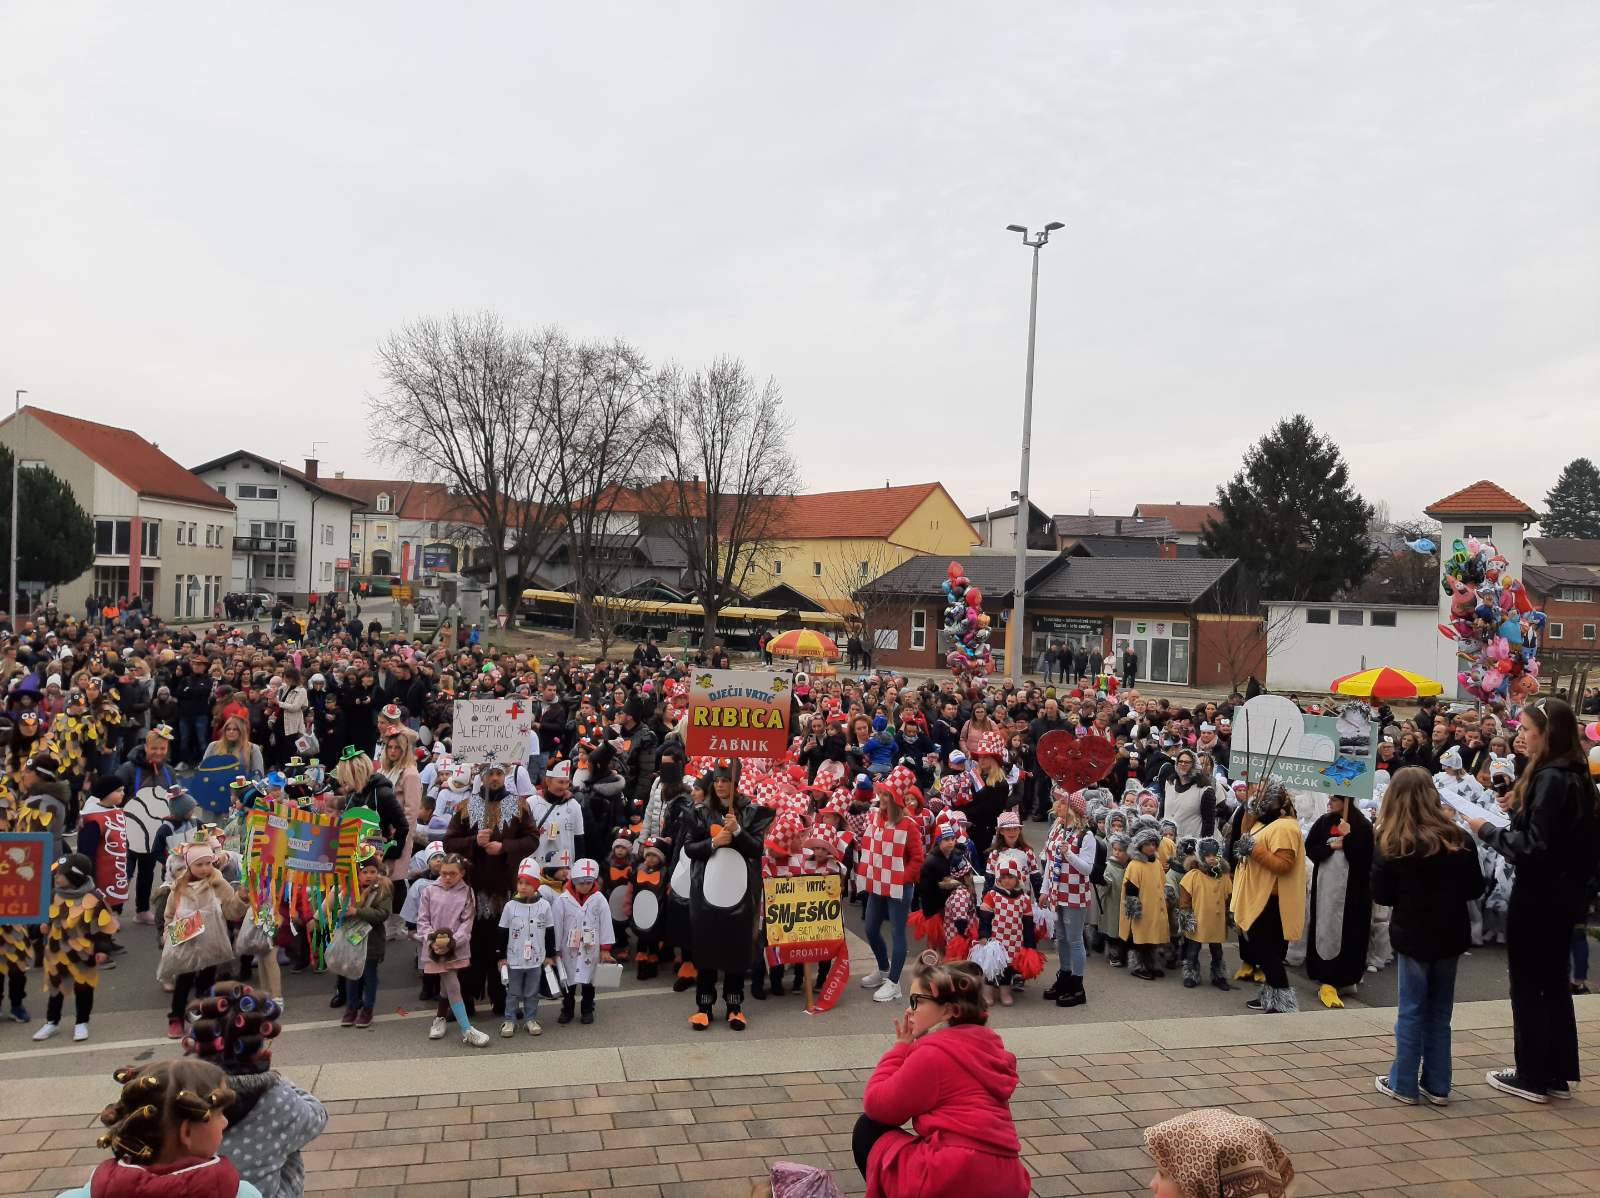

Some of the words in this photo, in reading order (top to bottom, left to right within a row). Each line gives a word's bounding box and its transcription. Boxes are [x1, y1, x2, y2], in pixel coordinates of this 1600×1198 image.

[708, 685, 743, 702] DJEČJI
[745, 687, 776, 704] VRTIĆ
[693, 706, 784, 729] RIBICA
[709, 735, 769, 752] ŽABNIK
[1279, 762, 1314, 773] VRTIĆ
[775, 878, 795, 895] DJEČJI
[806, 877, 826, 893] VRTIĆ
[789, 946, 829, 959] CROATIA
[823, 958, 849, 1001] CROATIA
